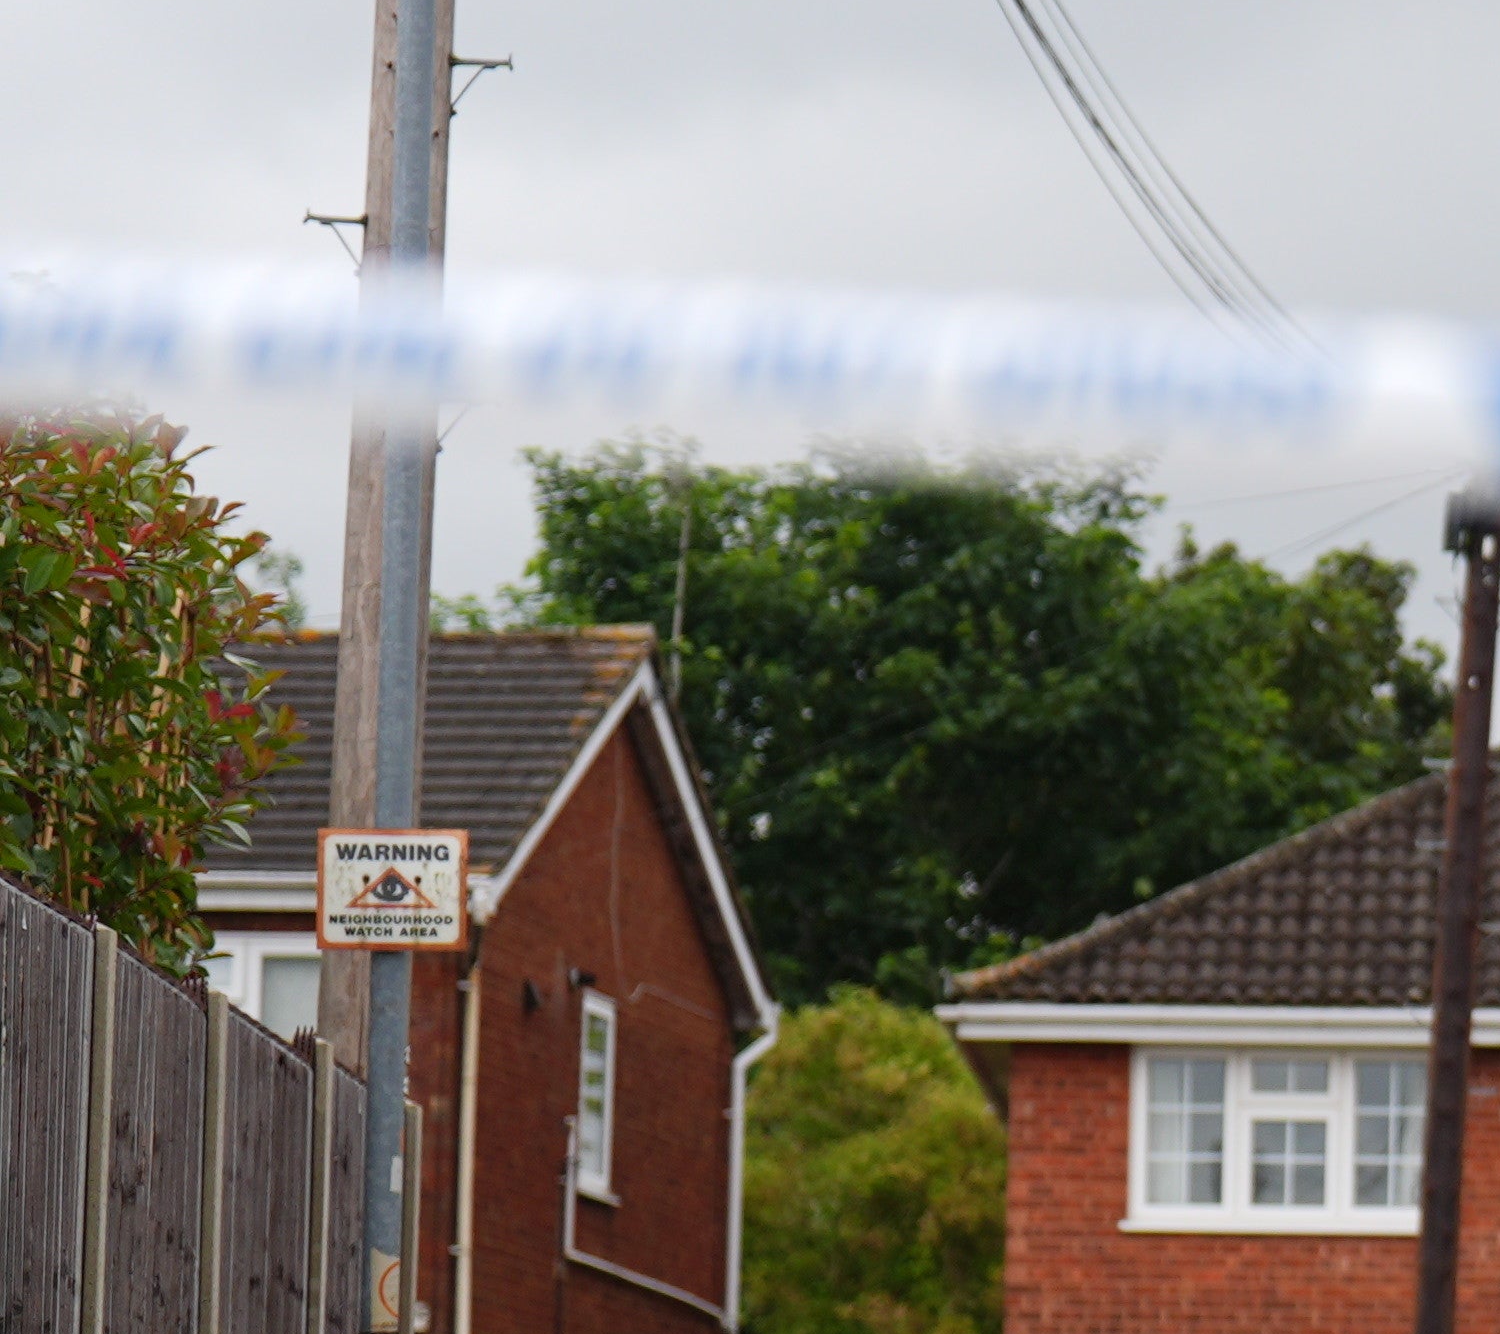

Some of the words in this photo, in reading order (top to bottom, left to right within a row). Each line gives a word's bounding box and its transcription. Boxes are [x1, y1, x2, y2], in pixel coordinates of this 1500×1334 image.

[336, 844, 450, 861] WARNING
[329, 914, 453, 925] NEIGHBOURHOOD
[344, 927, 393, 937] WATCH
[400, 927, 438, 937] AREA
